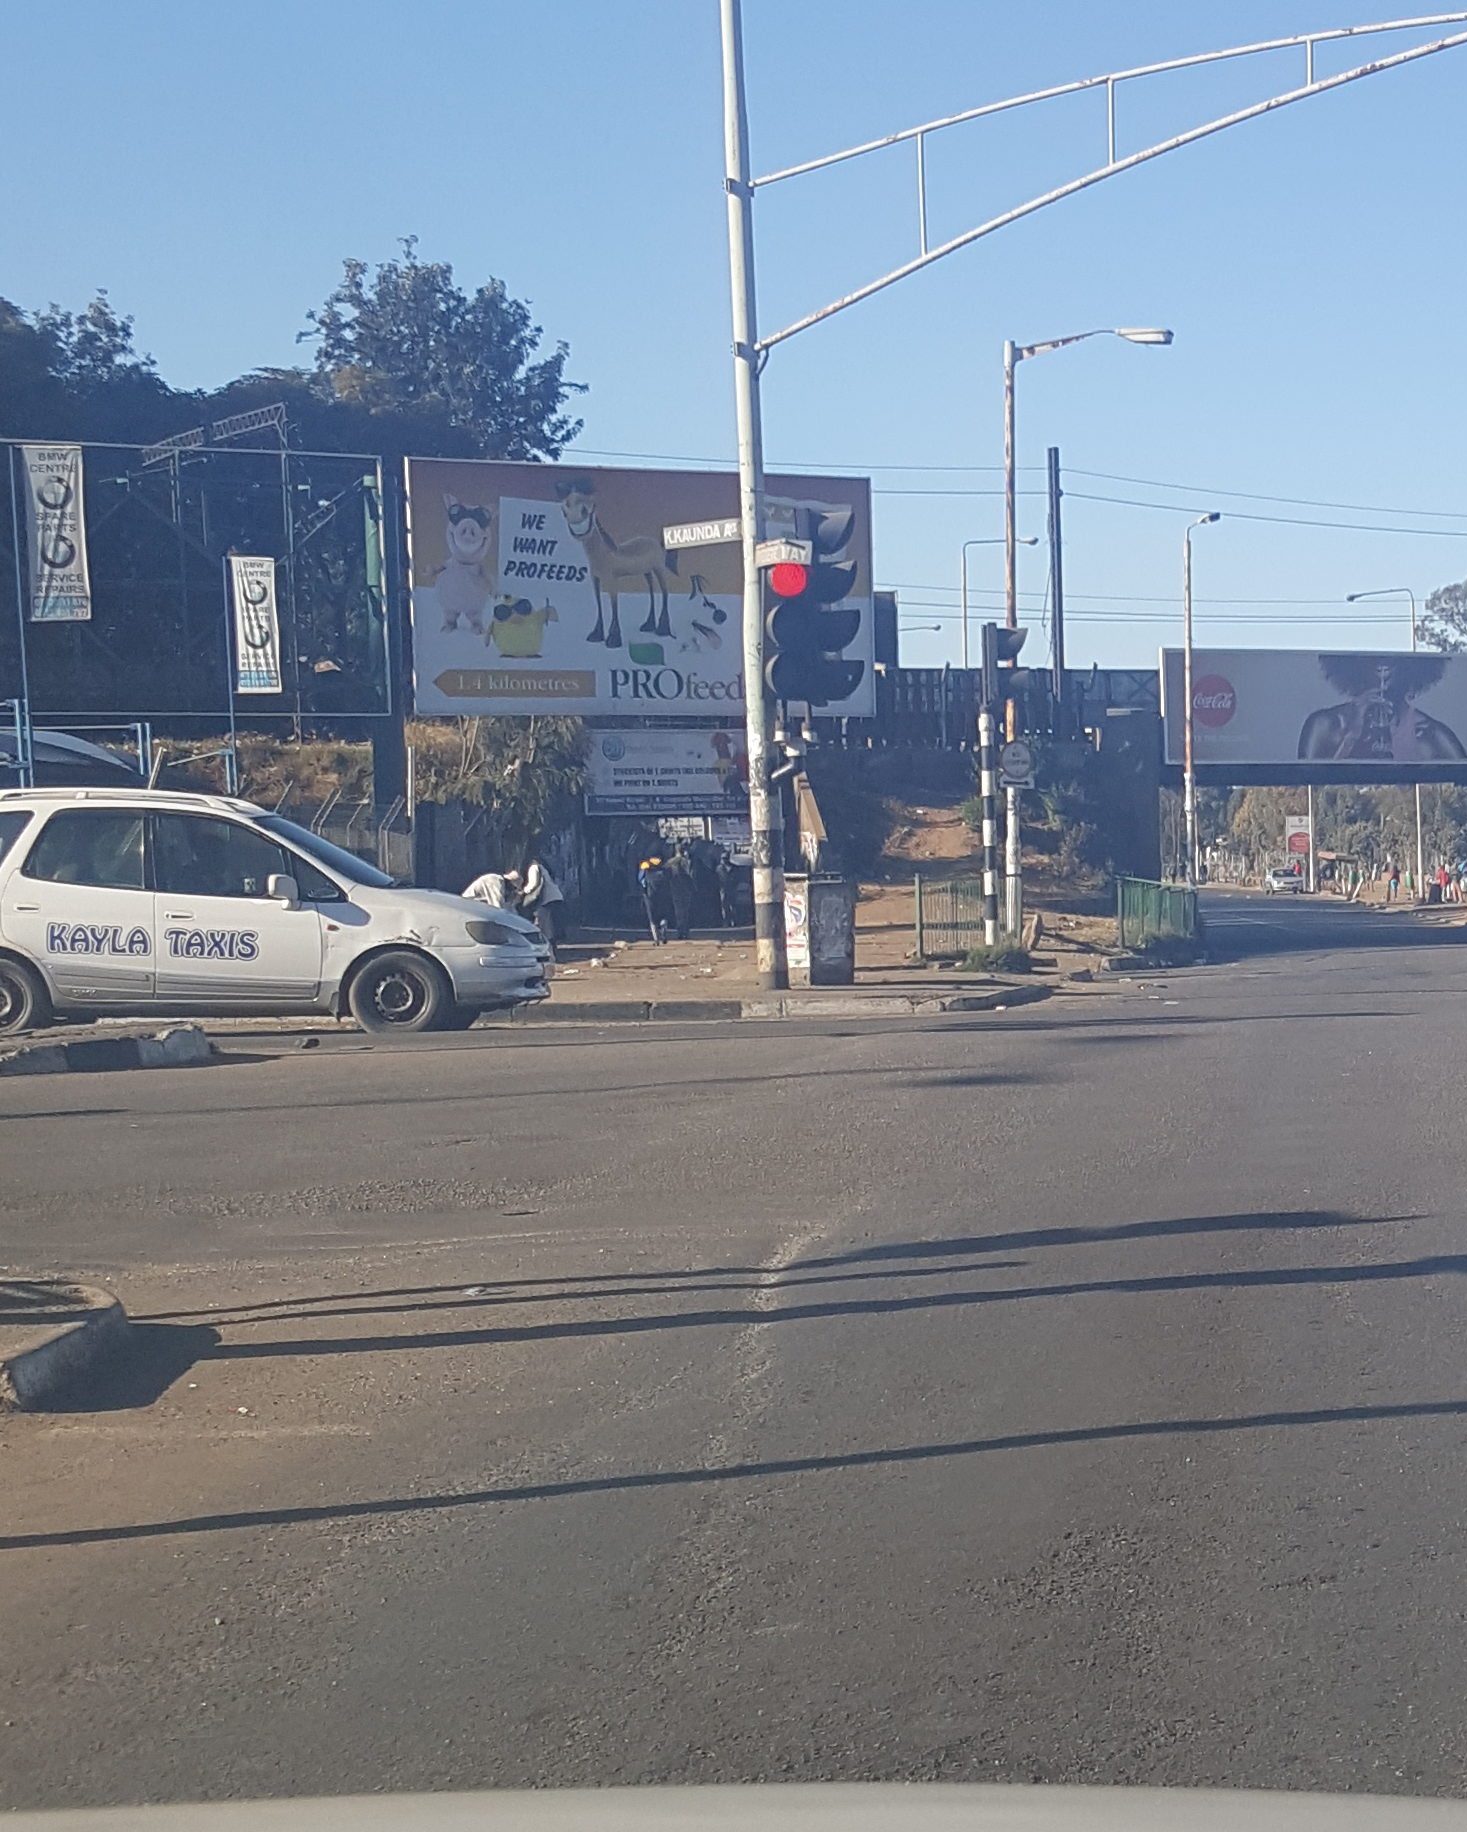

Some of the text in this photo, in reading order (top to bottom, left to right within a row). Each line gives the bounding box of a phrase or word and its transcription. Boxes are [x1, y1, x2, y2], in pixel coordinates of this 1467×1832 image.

[38, 452, 67, 461] BMW
[521, 513, 546, 531] WE
[664, 524, 721, 545] K.KAUNDA
[513, 536, 558, 556] WANT
[504, 560, 588, 582] PROFEEDS
[459, 674, 580, 691] 1.4 kilometres
[610, 668, 744, 700] PROfeed
[48, 923, 260, 961] KAYLA TAXIS
